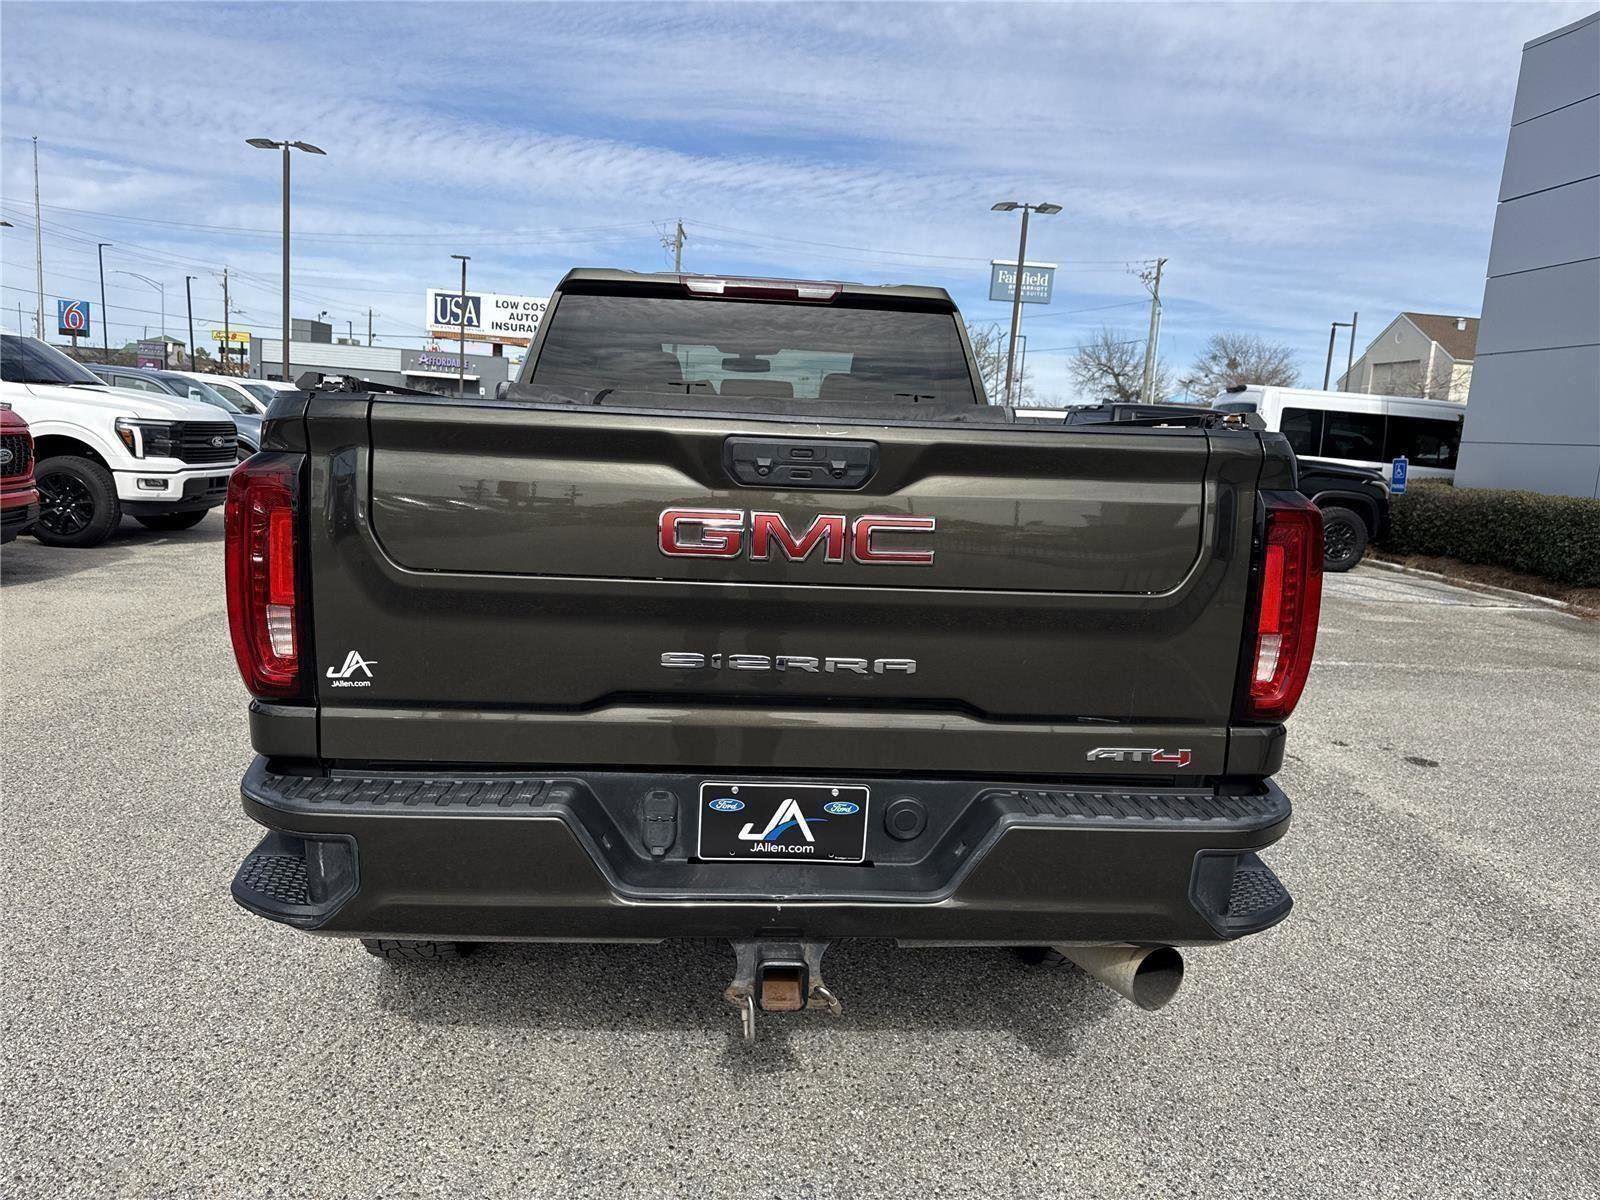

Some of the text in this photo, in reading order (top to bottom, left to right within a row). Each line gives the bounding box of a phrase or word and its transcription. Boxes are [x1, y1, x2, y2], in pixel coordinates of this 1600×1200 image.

[998, 270, 1049, 286] Faifield
[435, 296, 479, 326] USA
[495, 300, 546, 312] LOW COS
[63, 300, 85, 329] 6
[509, 312, 539, 323] AUTO
[491, 321, 539, 333] INSURAN
[418, 353, 470, 369] AFFORDABE
[657, 507, 937, 566] GMC
[660, 652, 917, 675] SIERRA
[1086, 747, 1192, 768] AT4
[714, 799, 738, 811] Ford
[829, 802, 853, 814] Ford
[749, 842, 815, 854] JAllen.com
